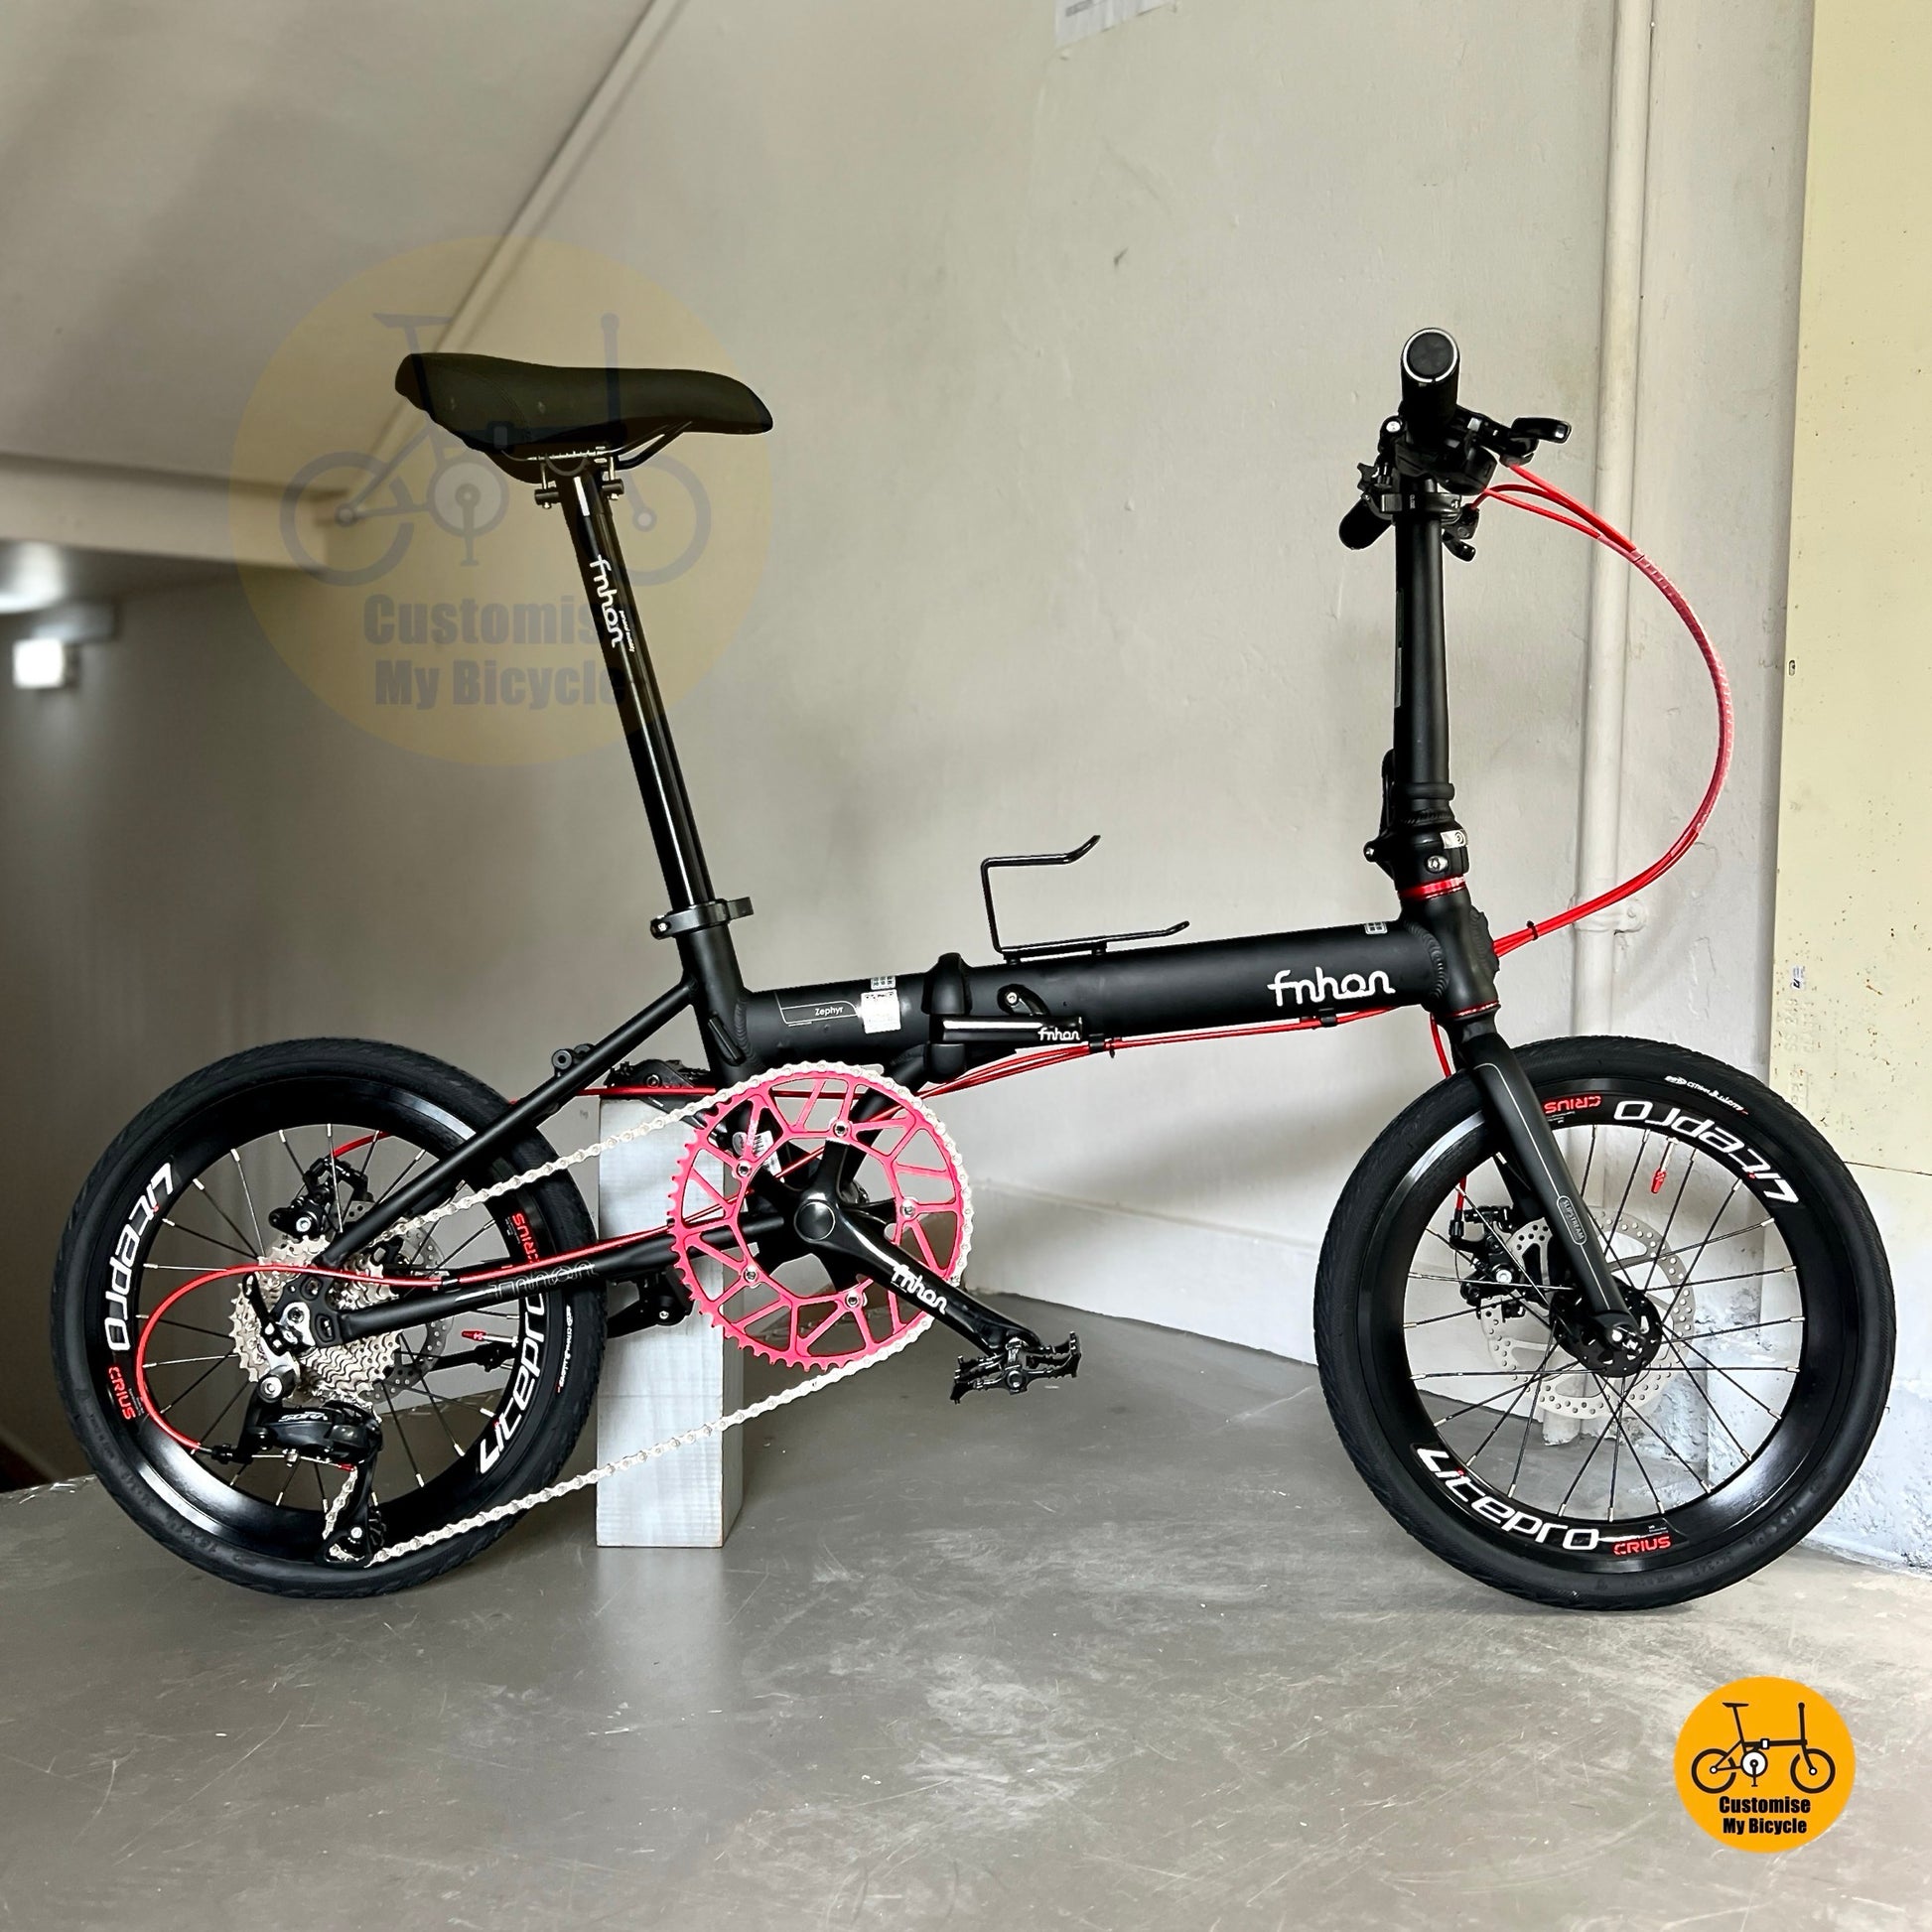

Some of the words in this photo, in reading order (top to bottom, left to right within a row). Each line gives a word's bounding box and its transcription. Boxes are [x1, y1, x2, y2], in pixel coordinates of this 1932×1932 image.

[589, 554, 624, 649] fnhon
[1267, 966, 1396, 1008] fnhon
[814, 1006, 844, 1018] Zephyr
[1036, 1026, 1081, 1041] fnhon
[1544, 1095, 1602, 1114] CRIUS
[891, 1263, 948, 1315] fnhon
[108, 1366, 137, 1420] CRIUS
[1613, 1535, 1672, 1556] CRIUS
